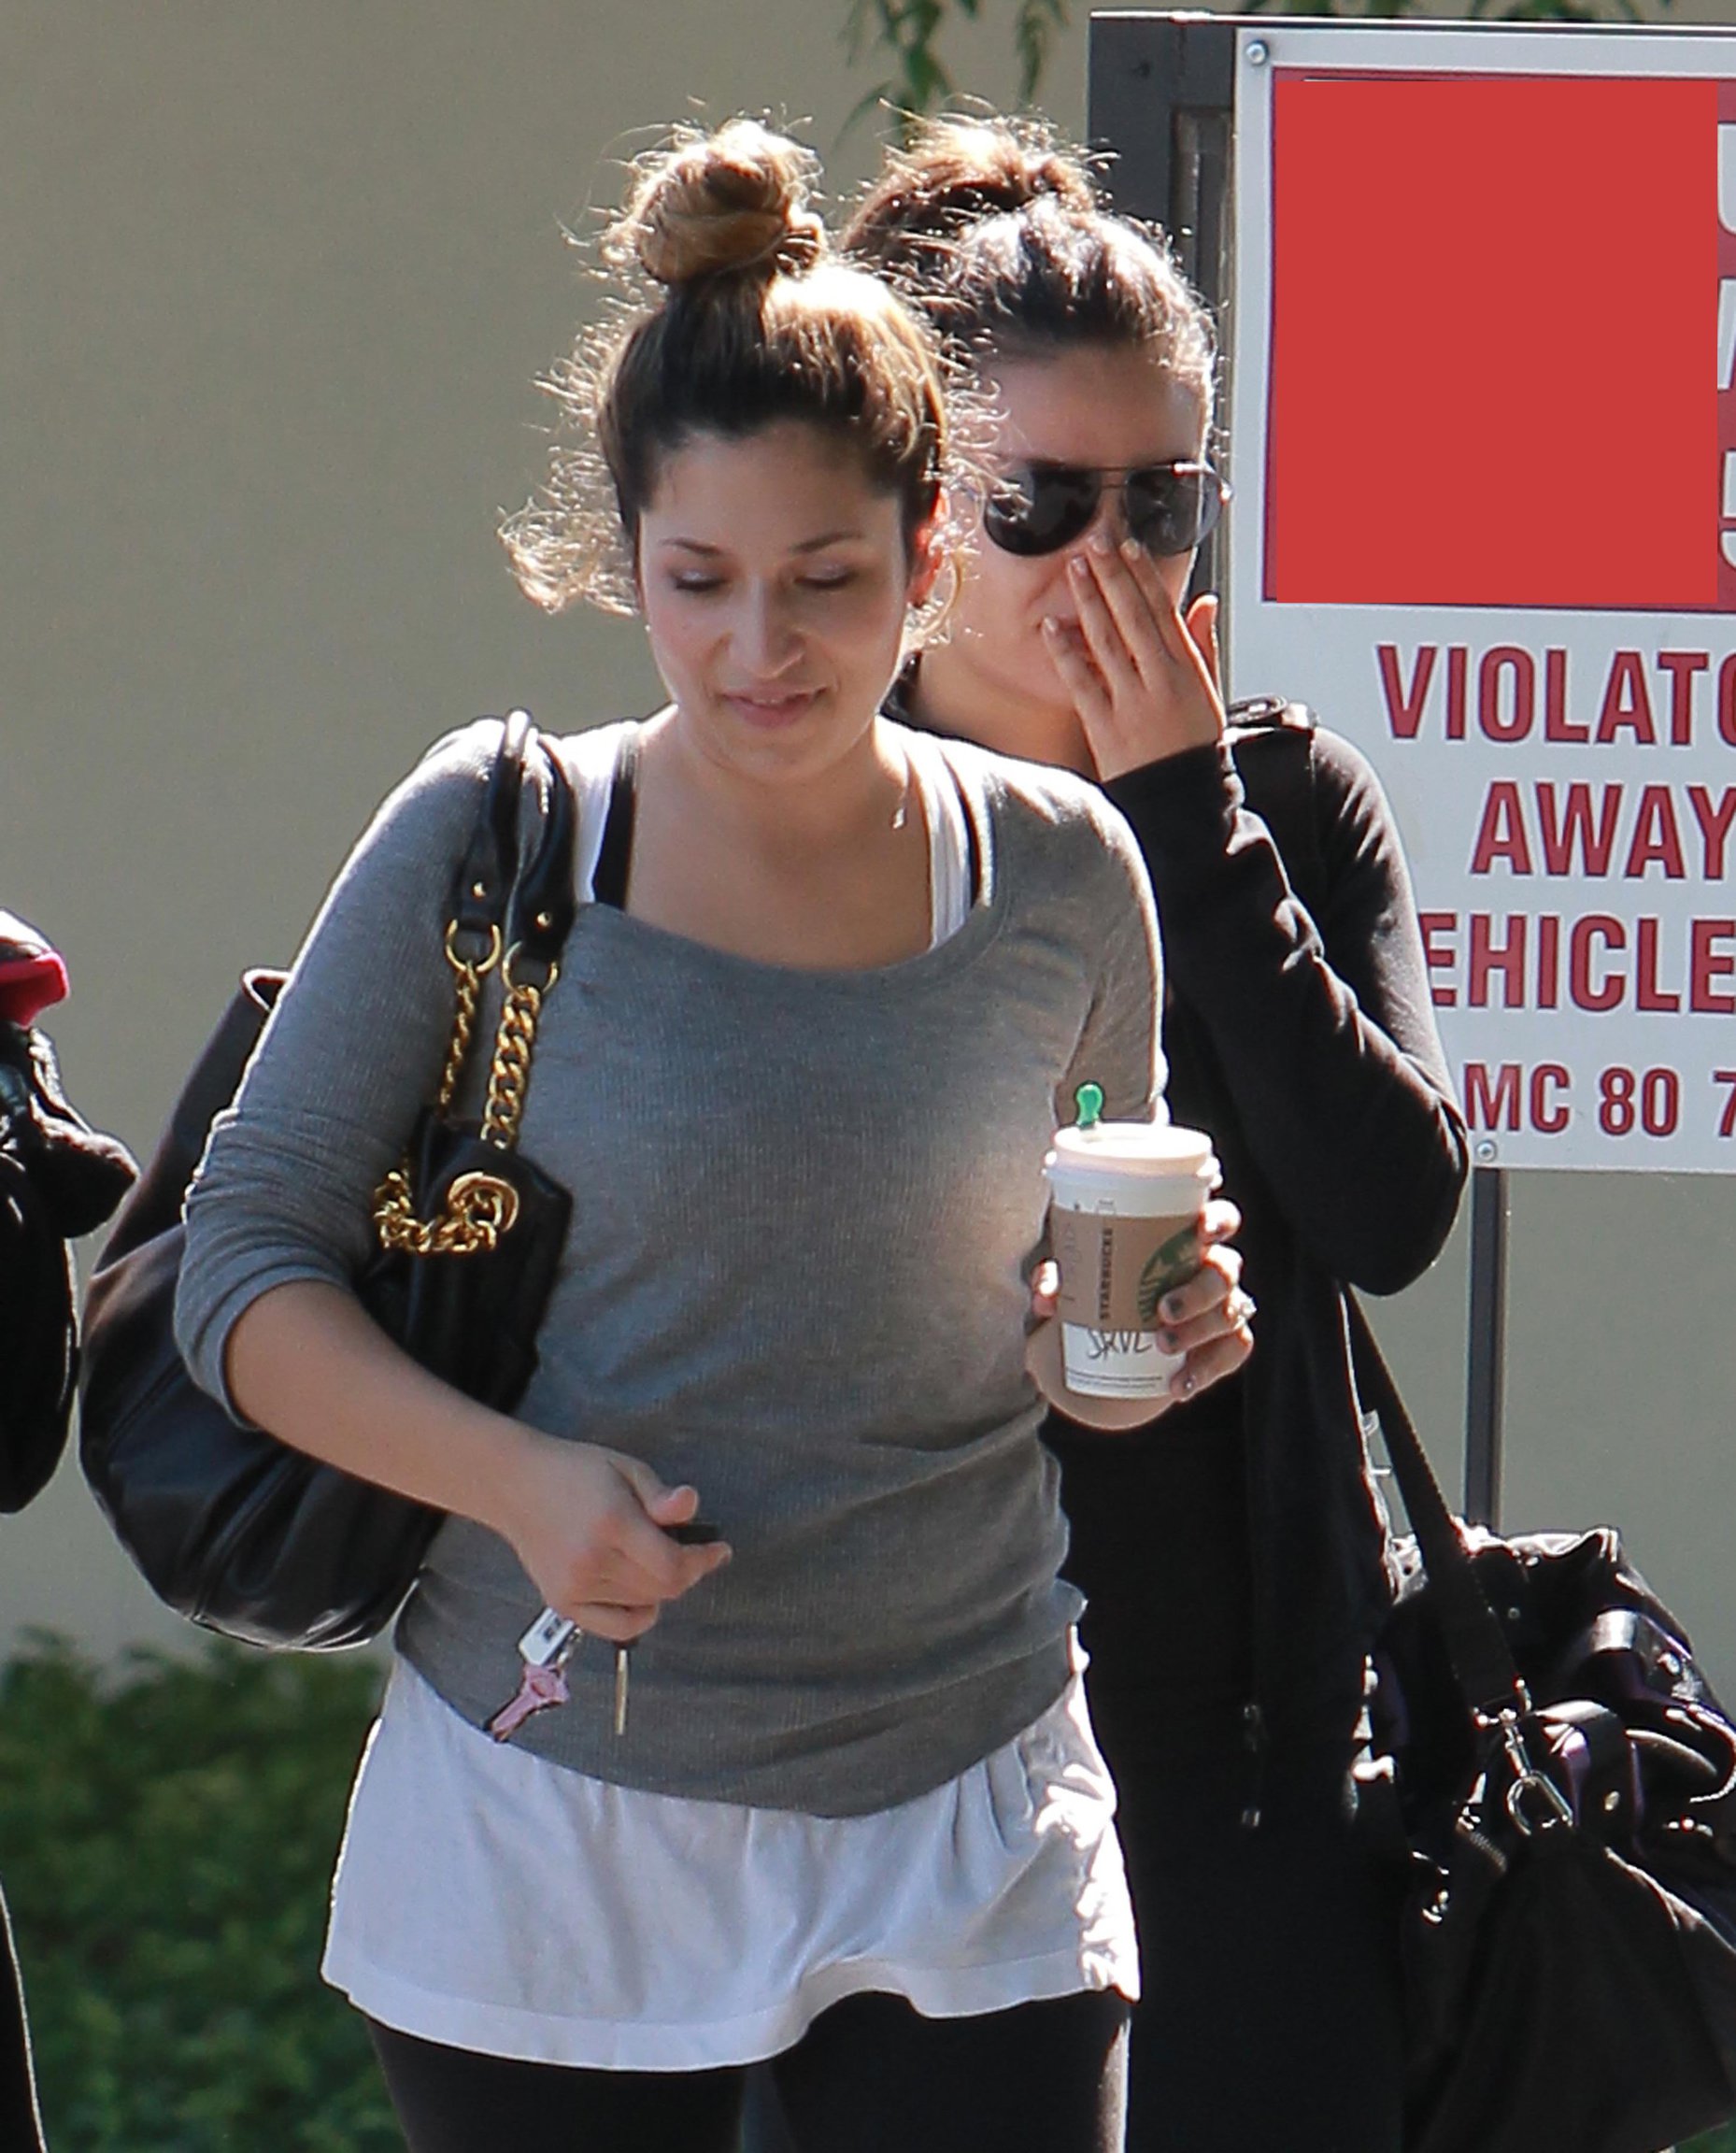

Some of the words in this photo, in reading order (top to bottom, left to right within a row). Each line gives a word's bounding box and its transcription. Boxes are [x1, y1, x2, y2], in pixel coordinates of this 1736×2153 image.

[1470, 780, 1736, 880] AWAY
[1598, 1066, 1679, 1137] 80
[1099, 1228, 1113, 1320] STARBUCKS
